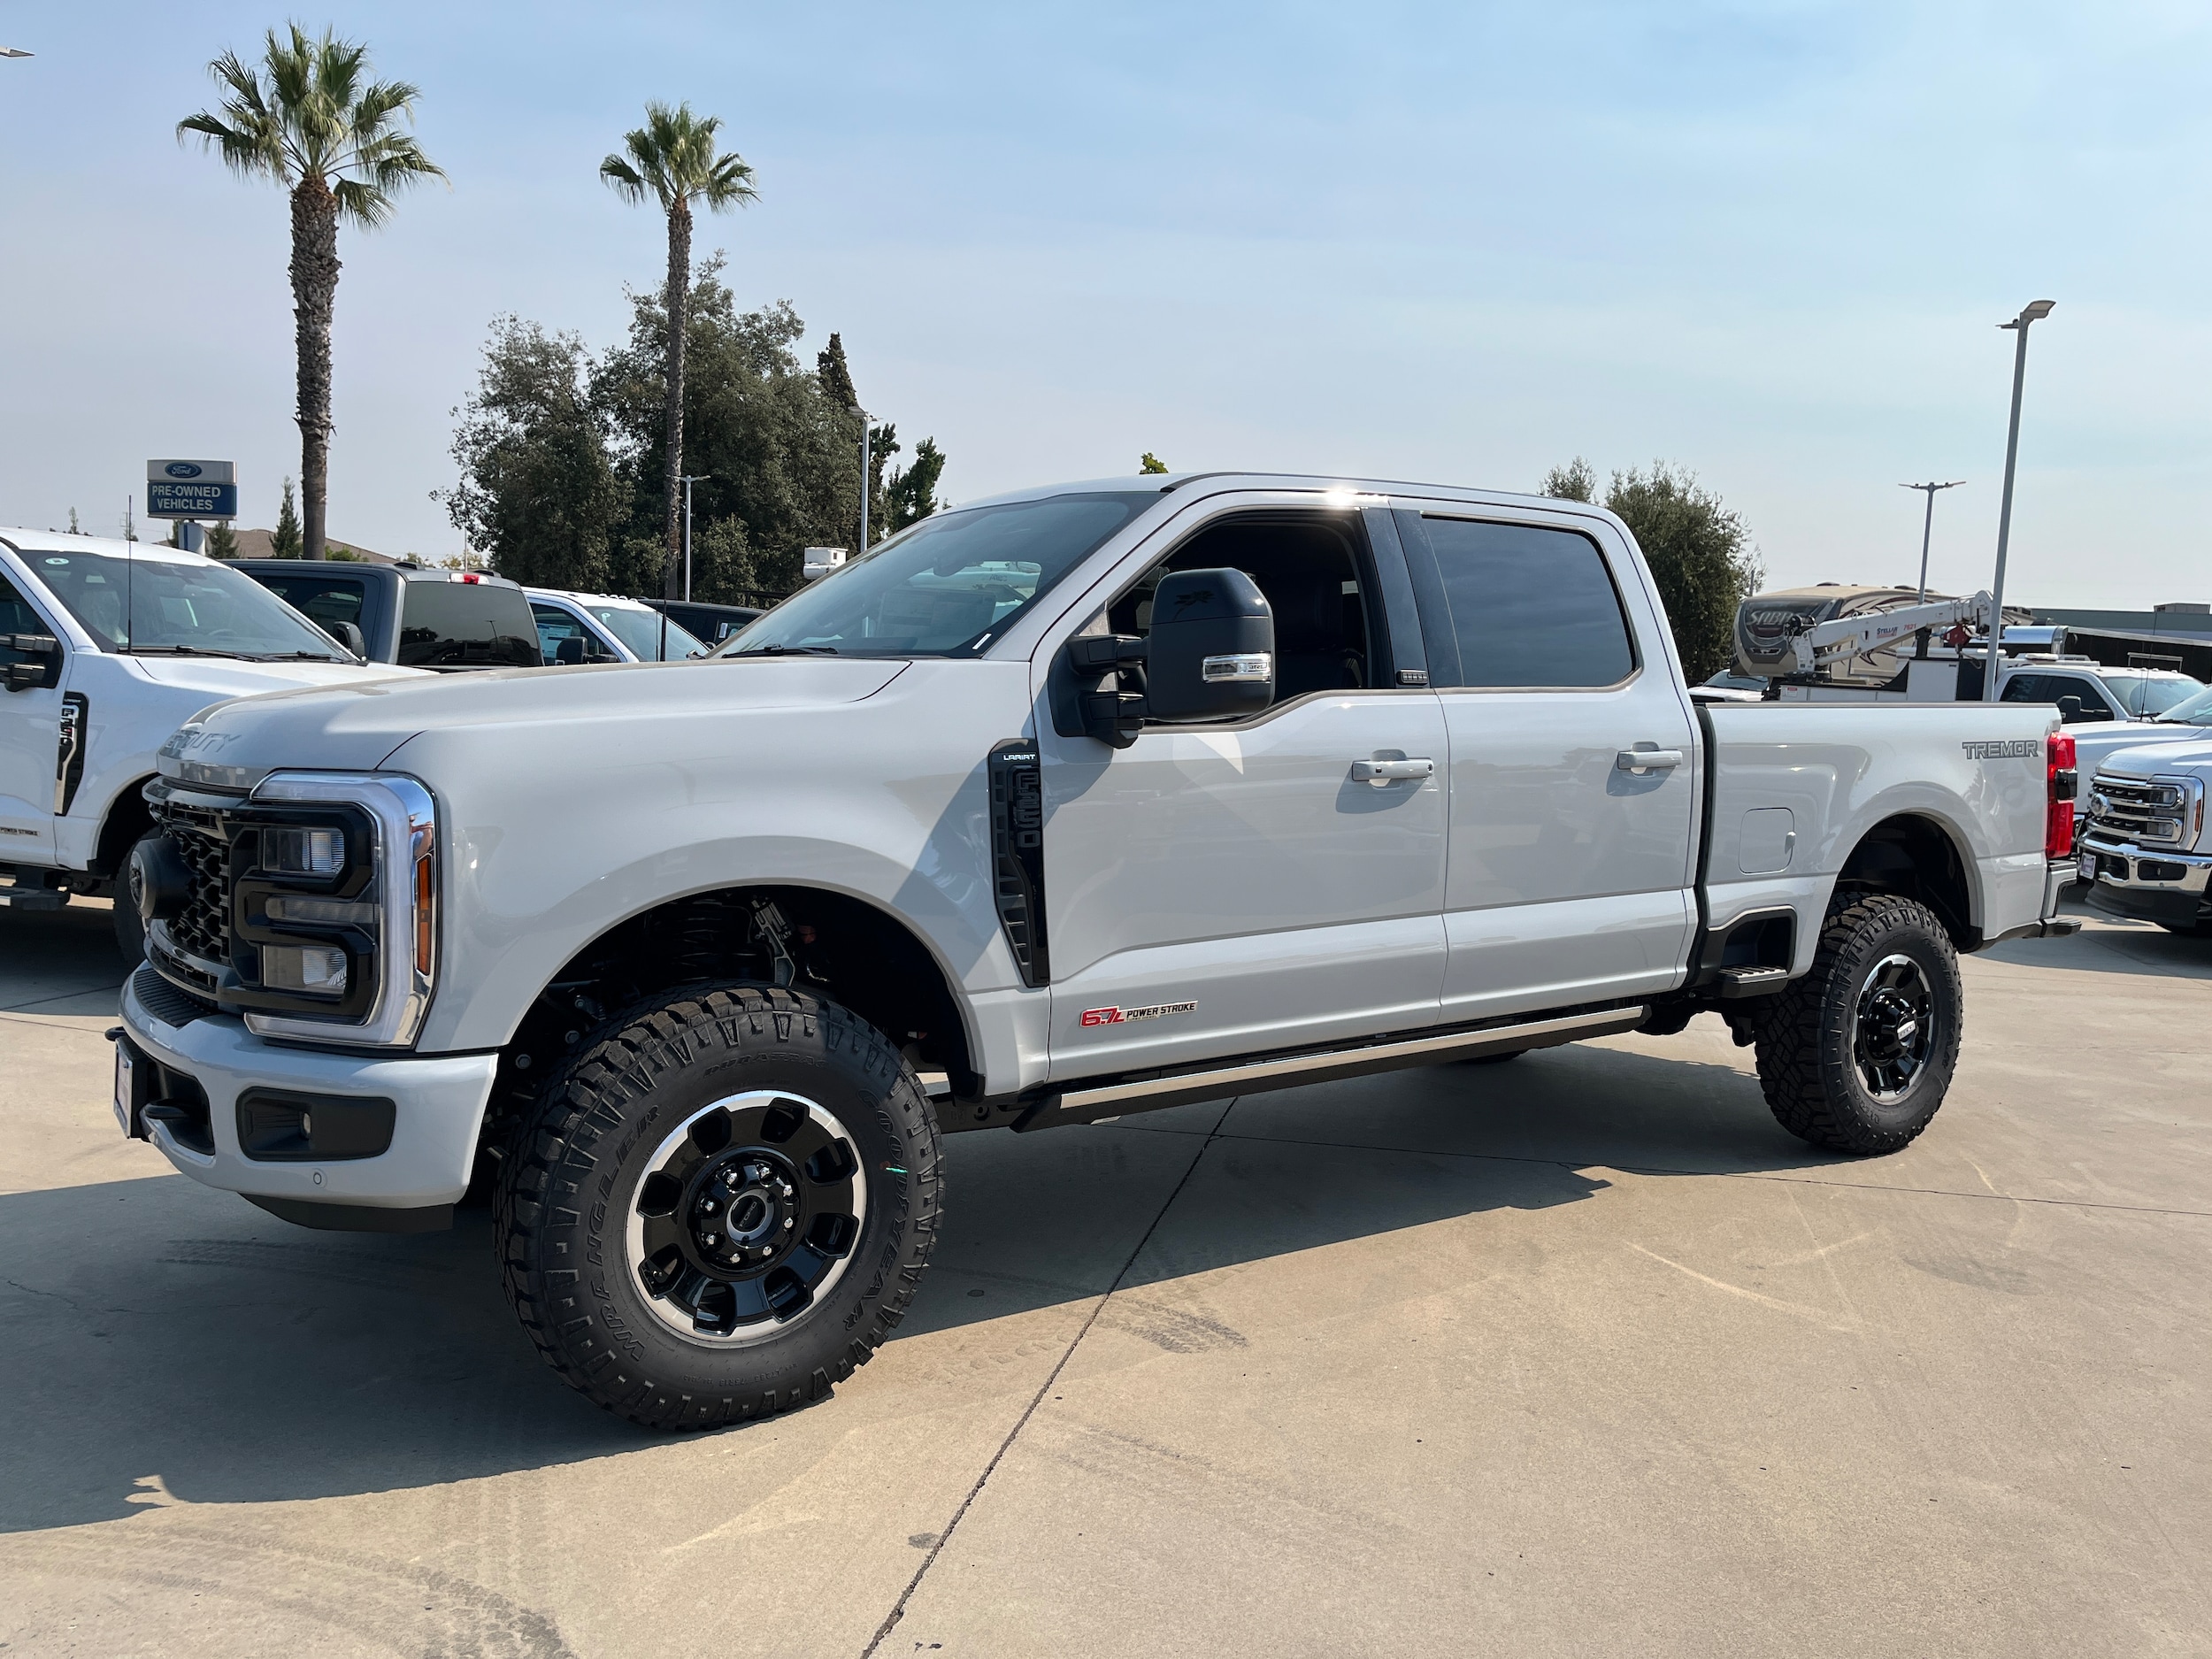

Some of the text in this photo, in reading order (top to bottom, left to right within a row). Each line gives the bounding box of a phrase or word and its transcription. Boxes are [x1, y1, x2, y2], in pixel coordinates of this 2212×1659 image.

[171, 465, 192, 475] Ford
[152, 486, 221, 497] PRE-OWNED
[157, 498, 213, 511] VEHICLES
[1748, 610, 1800, 626] SABR
[1962, 741, 2039, 759] TREMOR
[1080, 1007, 1125, 1026] 6.7L
[1126, 1008, 1158, 1018] POWER
[1160, 1002, 1195, 1015] STROKE
[738, 1201, 757, 1227] FORD
[843, 1088, 910, 1331] GOODYEAR
[588, 1104, 660, 1362] WRANGLER
